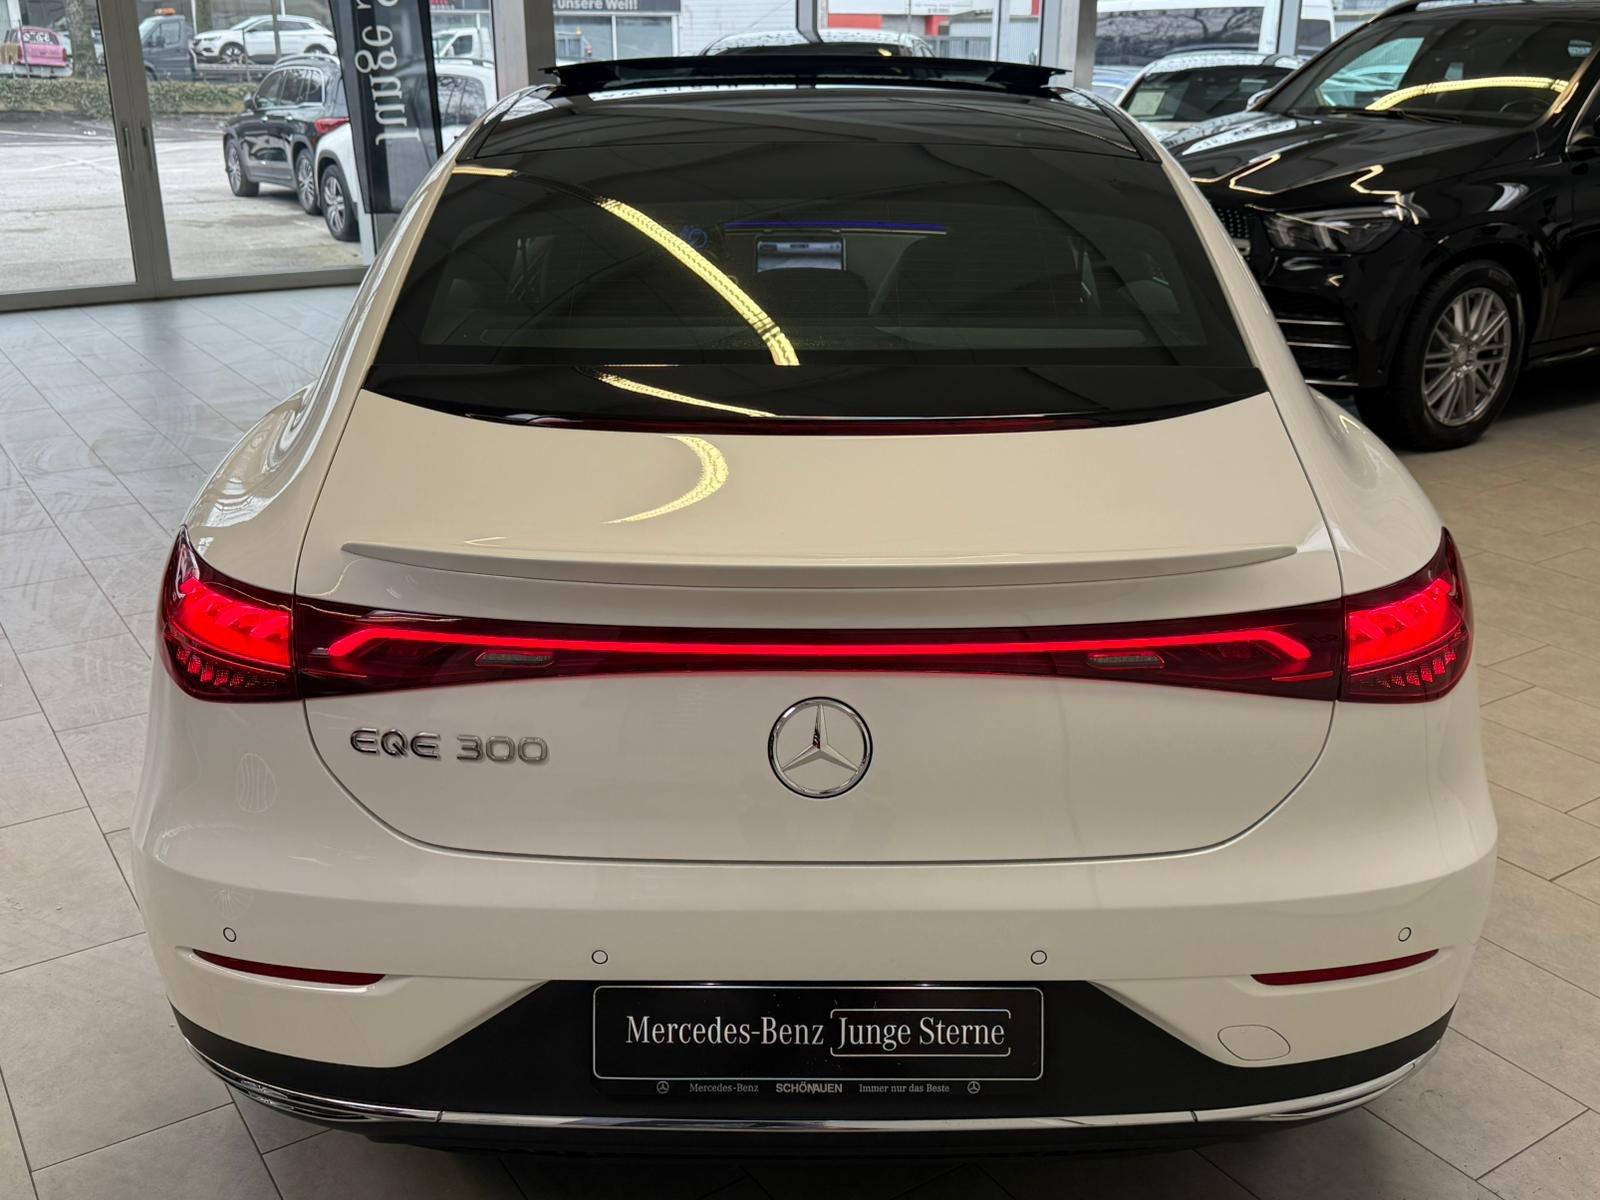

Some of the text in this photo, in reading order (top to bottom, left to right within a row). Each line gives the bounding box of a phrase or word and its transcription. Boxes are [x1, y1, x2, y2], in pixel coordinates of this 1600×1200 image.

[351, 728, 548, 763] EQE 300
[625, 1015, 1005, 1051] Mercedes-Benz Junge Sterne
[688, 1082, 759, 1093] Mercedes-Benz
[775, 1080, 843, 1094] SCHÖNAUEN
[858, 1083, 950, 1093] Immer nur das Beste
